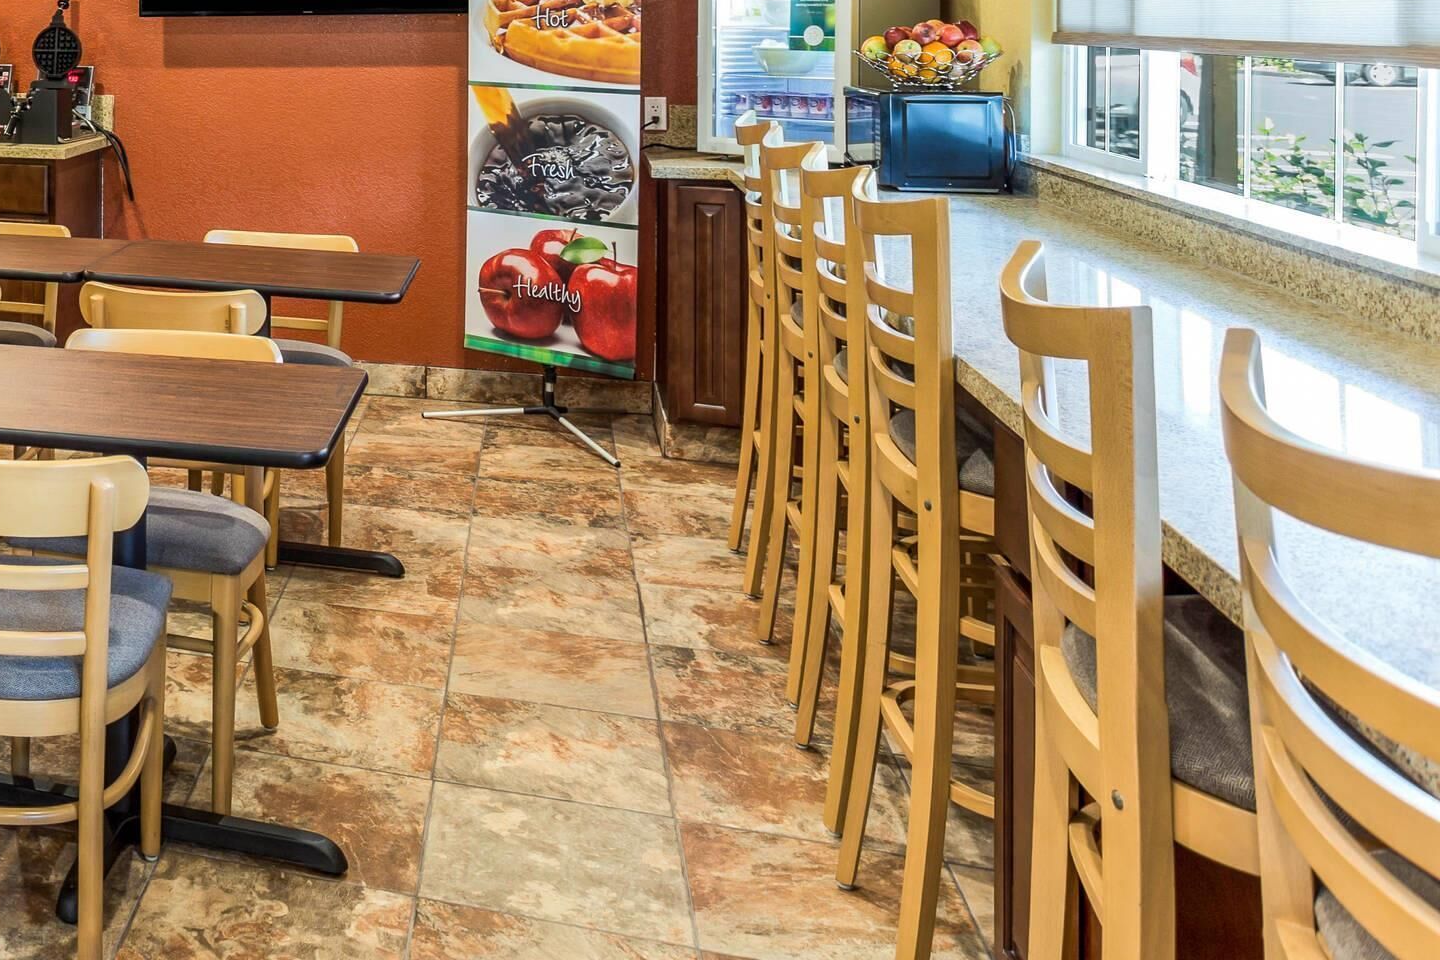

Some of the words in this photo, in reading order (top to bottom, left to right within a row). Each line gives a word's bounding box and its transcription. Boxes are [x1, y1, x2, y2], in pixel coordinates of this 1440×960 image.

[531, 5, 569, 30] Hot
[521, 153, 577, 180] Fresh
[512, 274, 582, 313] Healthy
